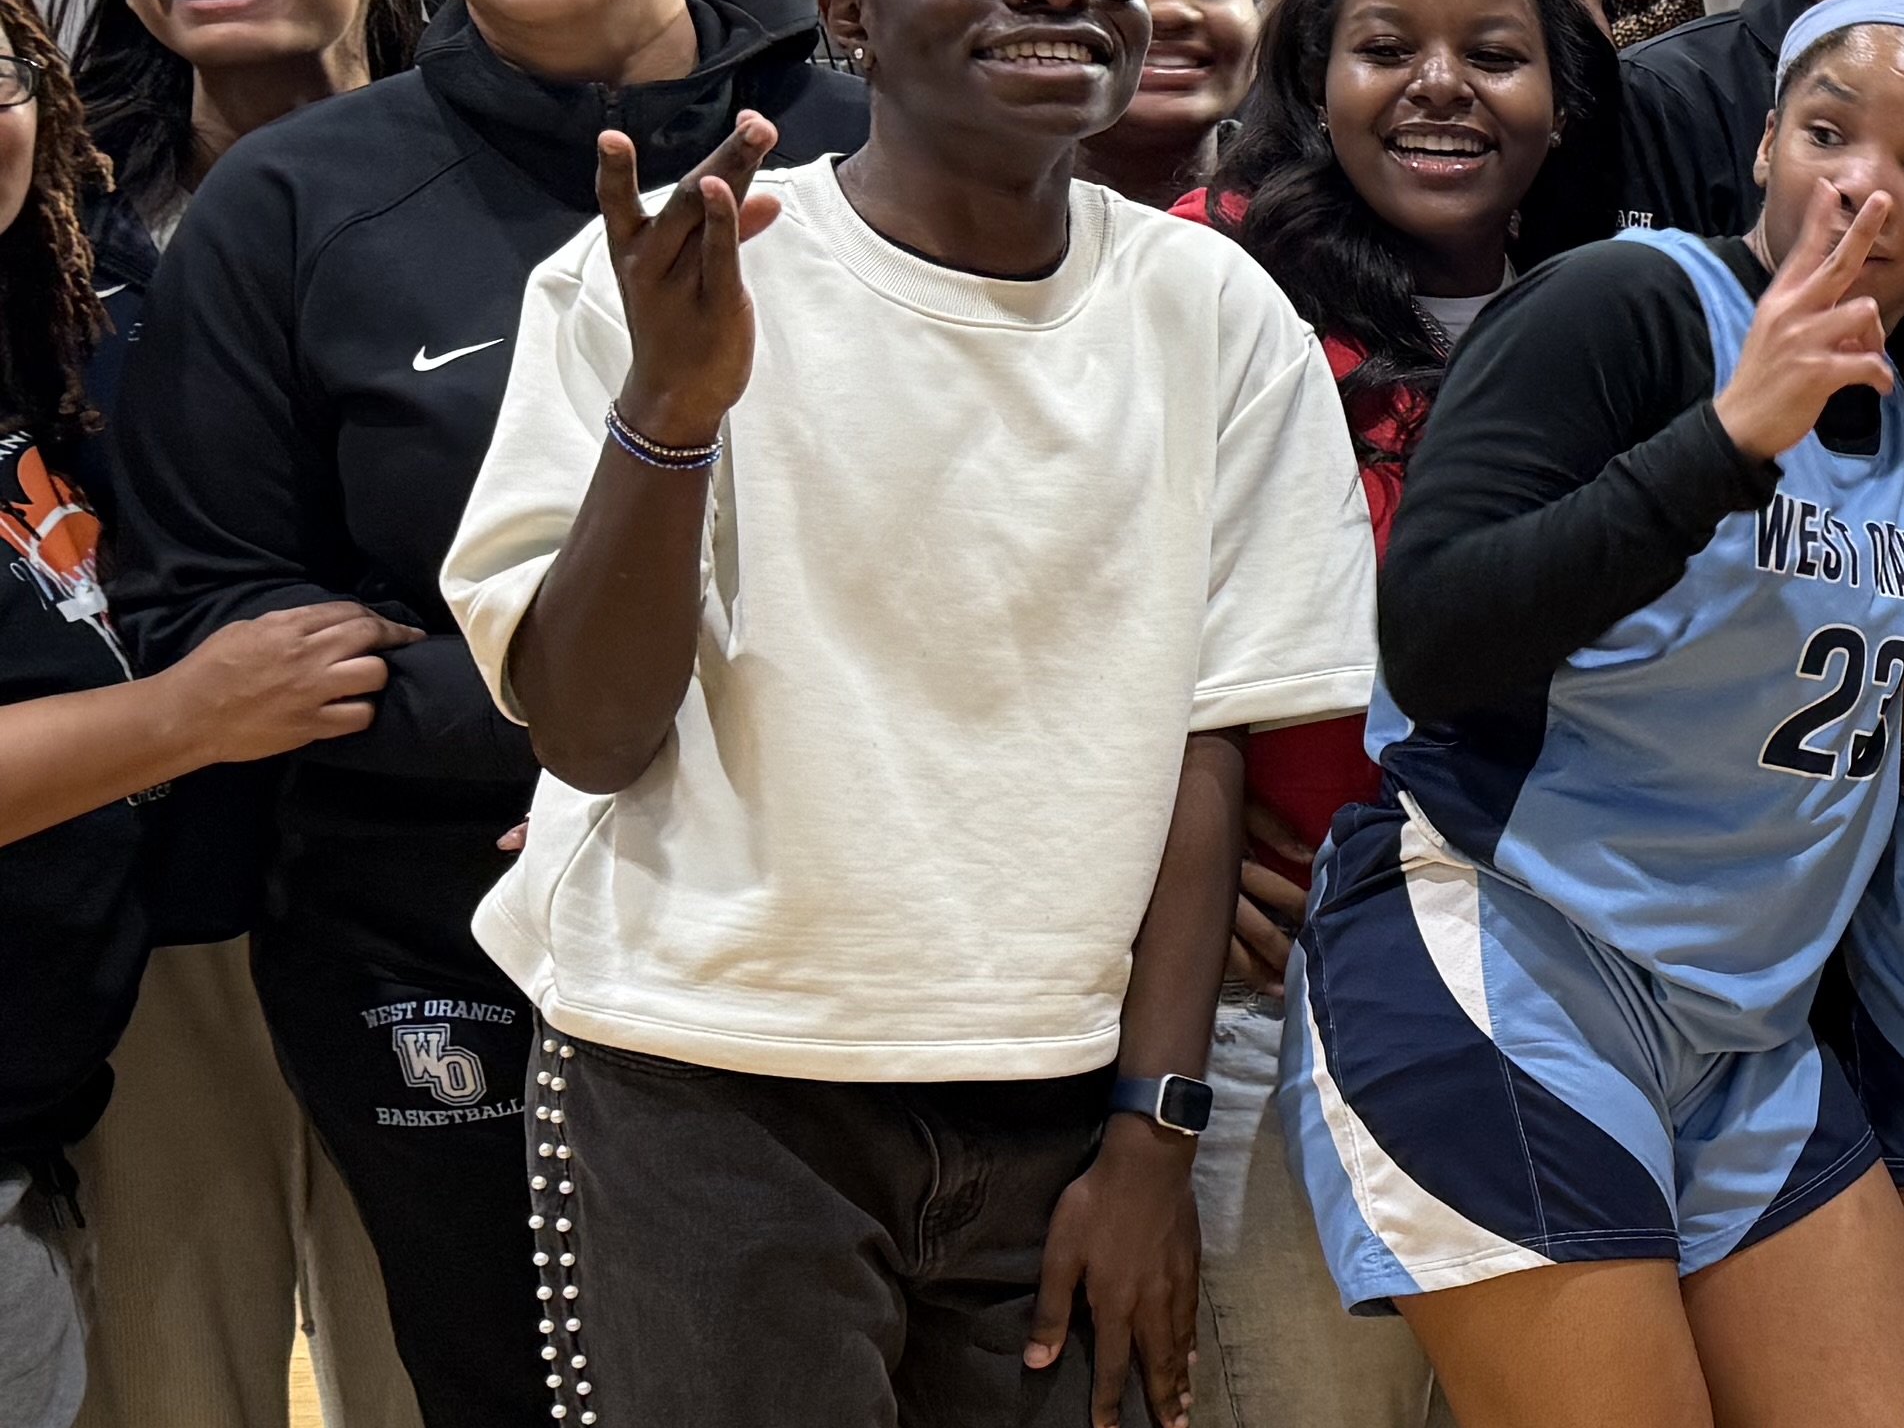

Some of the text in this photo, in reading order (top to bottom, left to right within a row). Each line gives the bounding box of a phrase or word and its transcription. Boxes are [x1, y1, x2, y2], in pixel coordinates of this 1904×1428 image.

[1756, 491, 1861, 588] WEST
[361, 999, 516, 1029] WEST ORANGE
[392, 1023, 487, 1106] WO
[375, 1098, 526, 1127] BASKETBALL
